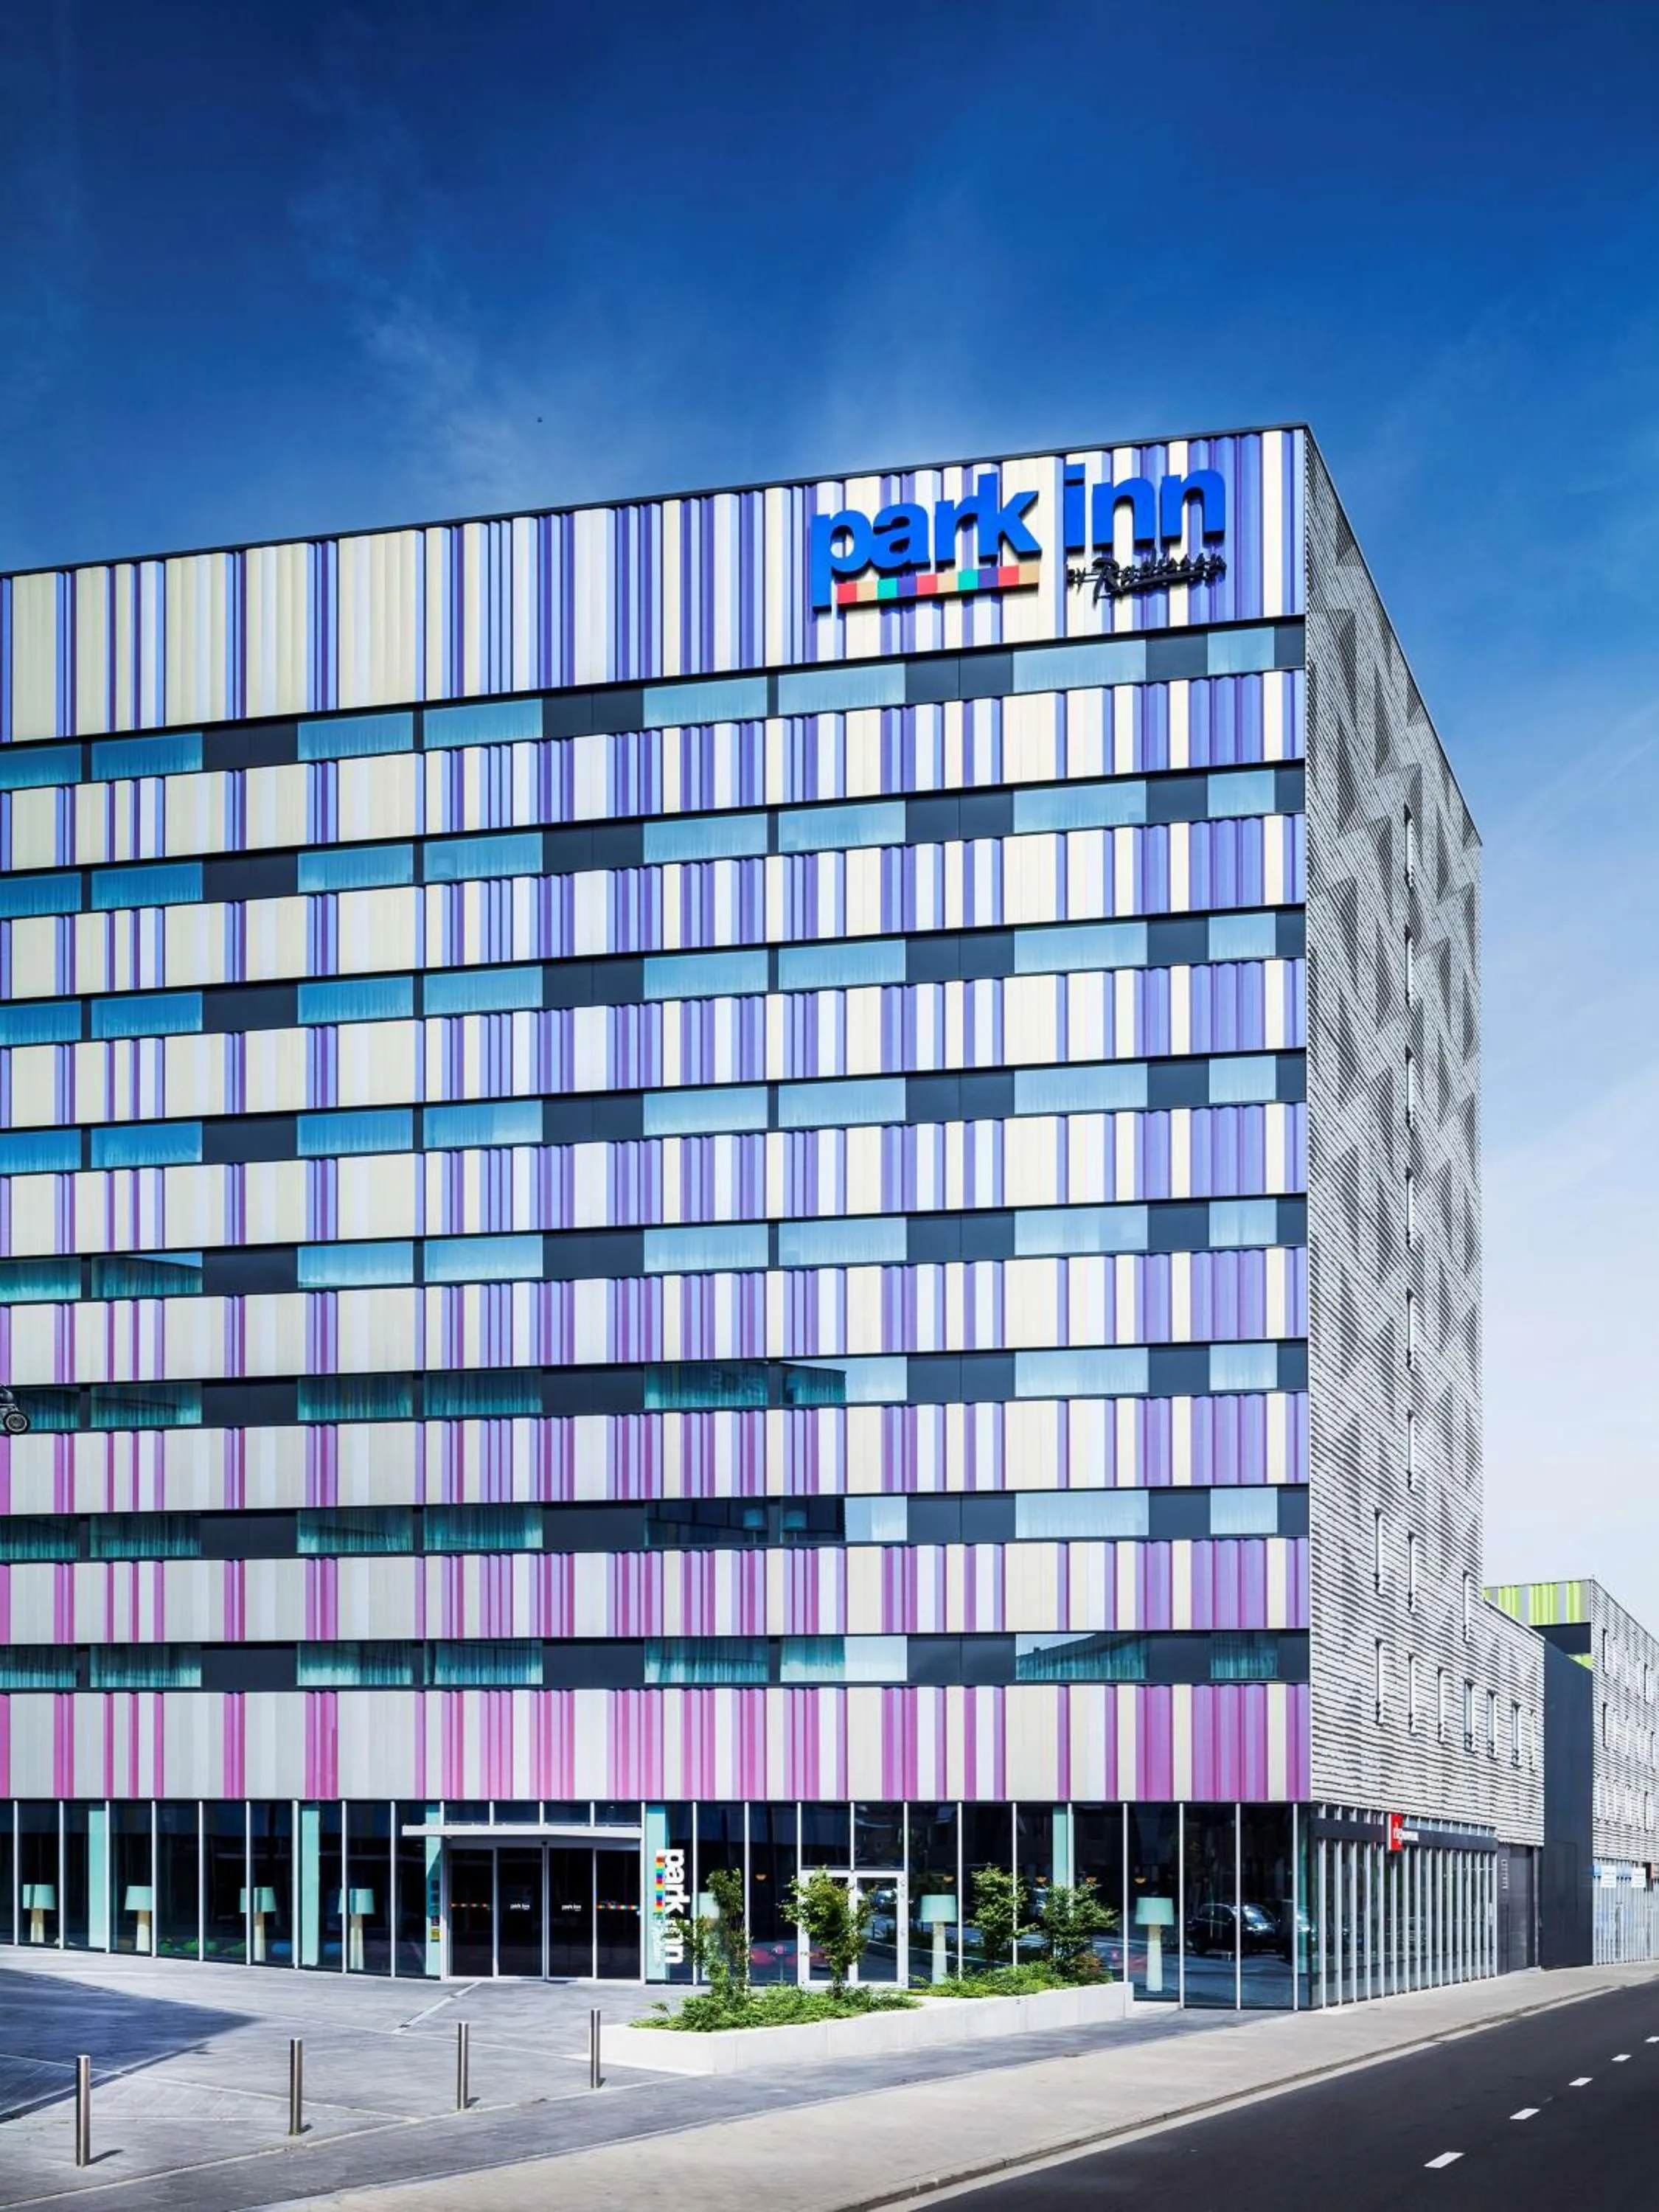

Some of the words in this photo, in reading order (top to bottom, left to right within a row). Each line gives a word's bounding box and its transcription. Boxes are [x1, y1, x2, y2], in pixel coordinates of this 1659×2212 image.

[812, 473, 1042, 607] park
[1064, 463, 1227, 547] inn
[656, 1849, 690, 1916] park
